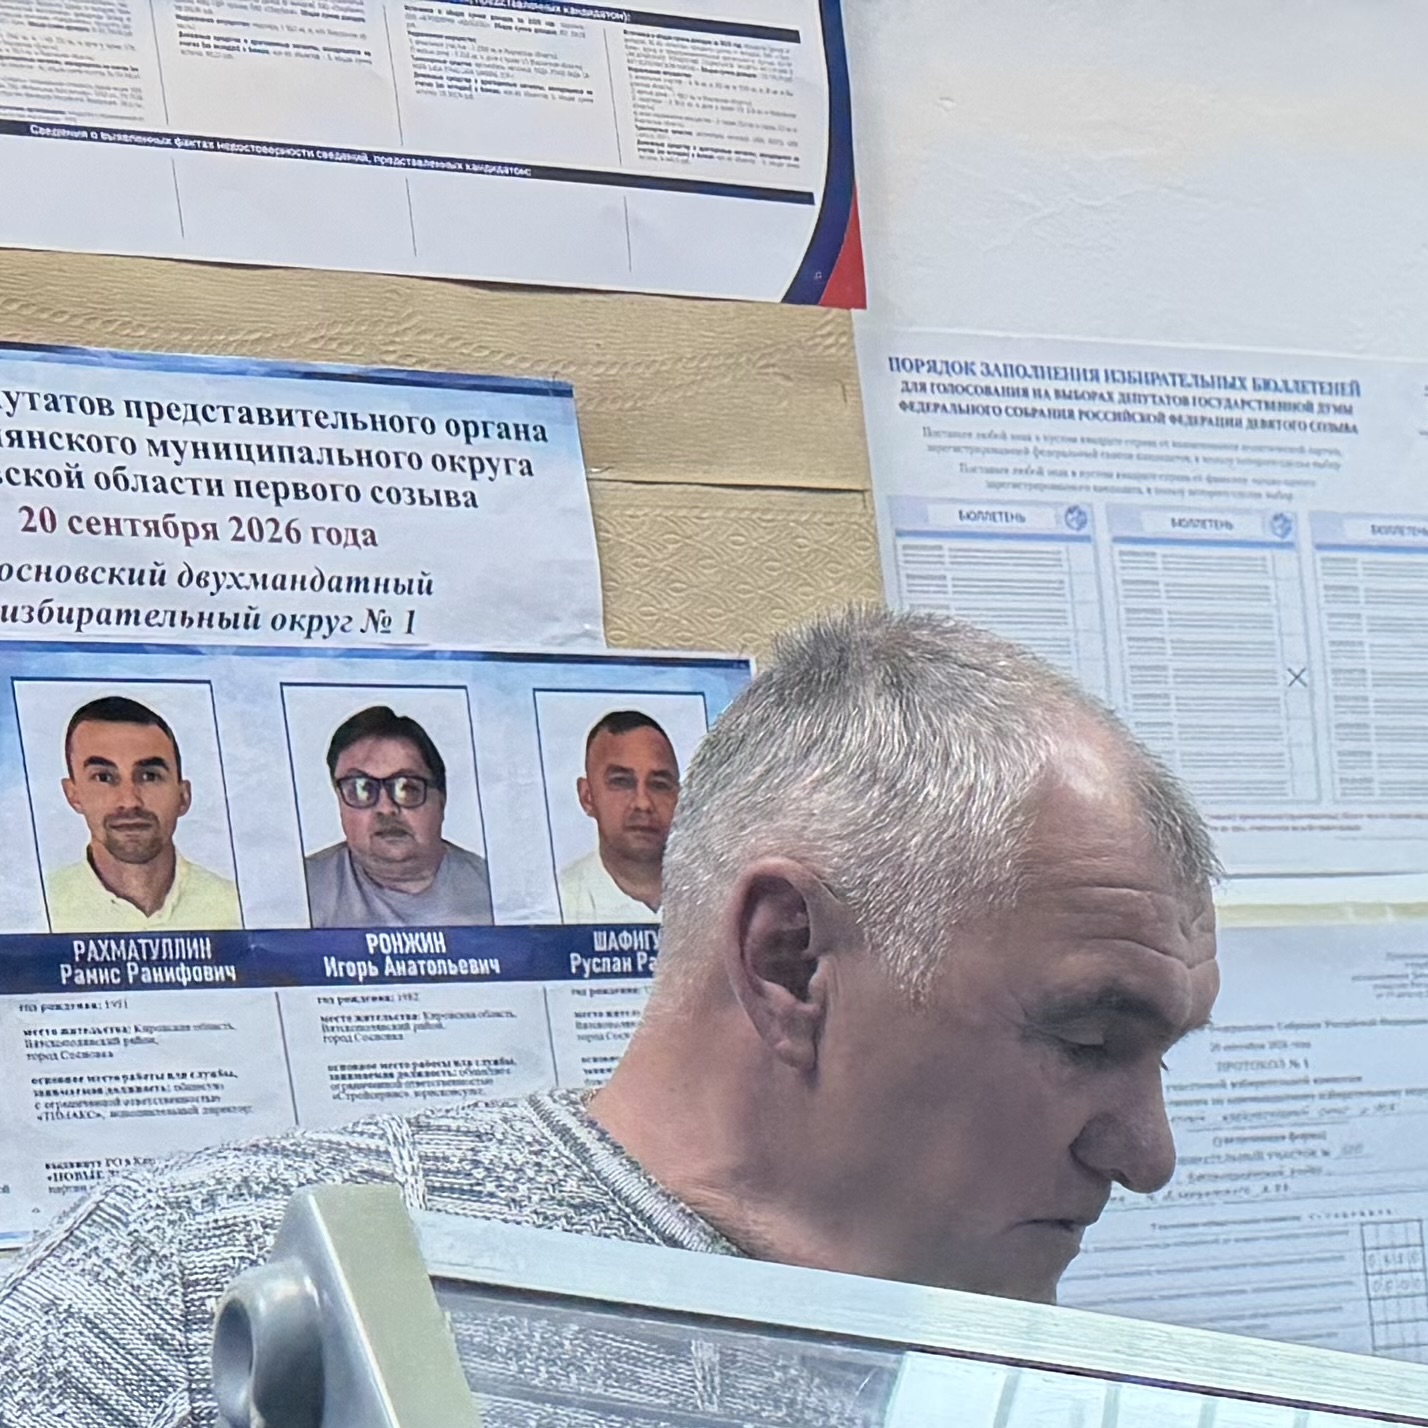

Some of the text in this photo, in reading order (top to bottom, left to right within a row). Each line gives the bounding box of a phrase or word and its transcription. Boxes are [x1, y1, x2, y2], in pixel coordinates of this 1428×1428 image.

[888, 356, 1362, 398] ПОРЯДОК ЗАПОЛНЕНИЯ ИЗБИРАТЕЛЬНЫХ БЮЛЛЕТЕНЕЙ
[898, 400, 1004, 417] ФЕДЕРАЛЬНОГО
[1005, 405, 1076, 421] СОБРАНИЯ
[1078, 408, 1166, 426] РОССИЙСКОЙ
[1168, 413, 1244, 430] ФЕДЕРАЦИИ
[900, 380, 1353, 416] ДЛЯ ГОЛОСОВАНИЯ НА ВЫБОРАХ ДЕПУТАТОВ ГОСУДАРСТВЕННОЙ ДУМЫ
[0, 390, 548, 445] утатов представительного органа
[146, 437, 423, 472] муниципального
[431, 452, 535, 481] округа
[0, 462, 479, 508] ской области первого созыва
[18, 505, 378, 550] 20 сентября 2026 года
[957, 508, 1026, 524] БЮЛЛЕТЕНЬ
[0, 561, 434, 596] основский двухмандатный
[0, 598, 417, 640] избирательный округ № 1
[73, 937, 213, 962] РАХМАТУЛЛИН
[366, 931, 447, 955] РОНЖИН
[60, 962, 237, 987] Рамис Ранифович
[323, 955, 502, 982] Игорь Анатольевич
[570, 951, 660, 978] Руслан Ра
